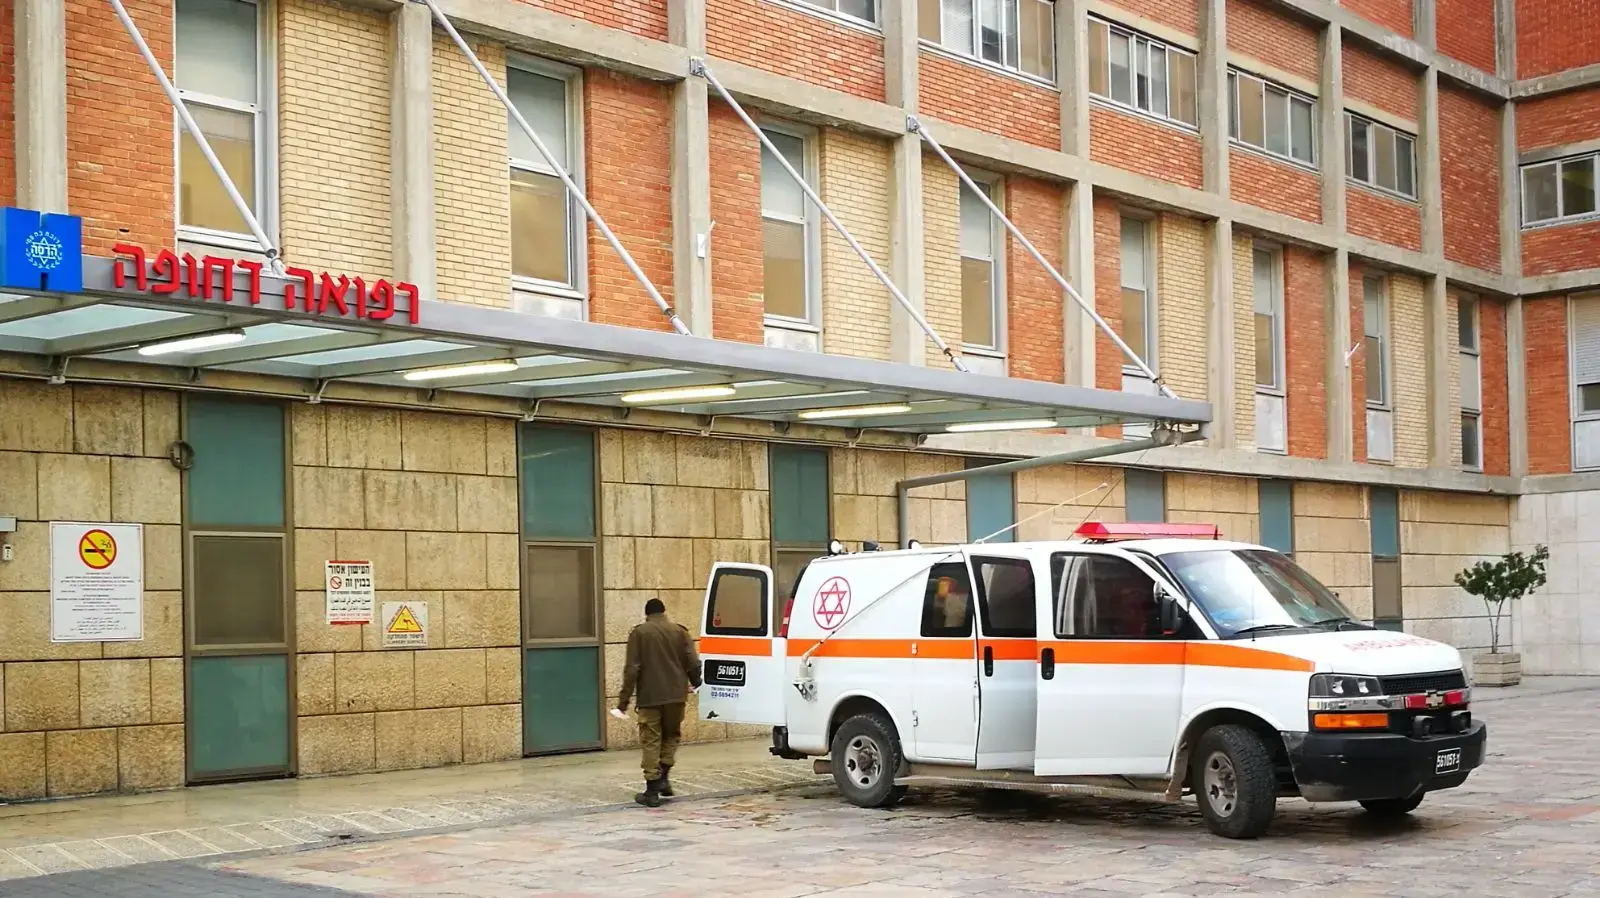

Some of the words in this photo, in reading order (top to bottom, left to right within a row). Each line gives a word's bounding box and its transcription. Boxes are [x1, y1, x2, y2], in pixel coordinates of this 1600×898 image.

[31, 245, 57, 257] הדסה
[111, 243, 264, 305] דחופה
[284, 266, 419, 325] רפואה
[328, 565, 345, 574] אסור
